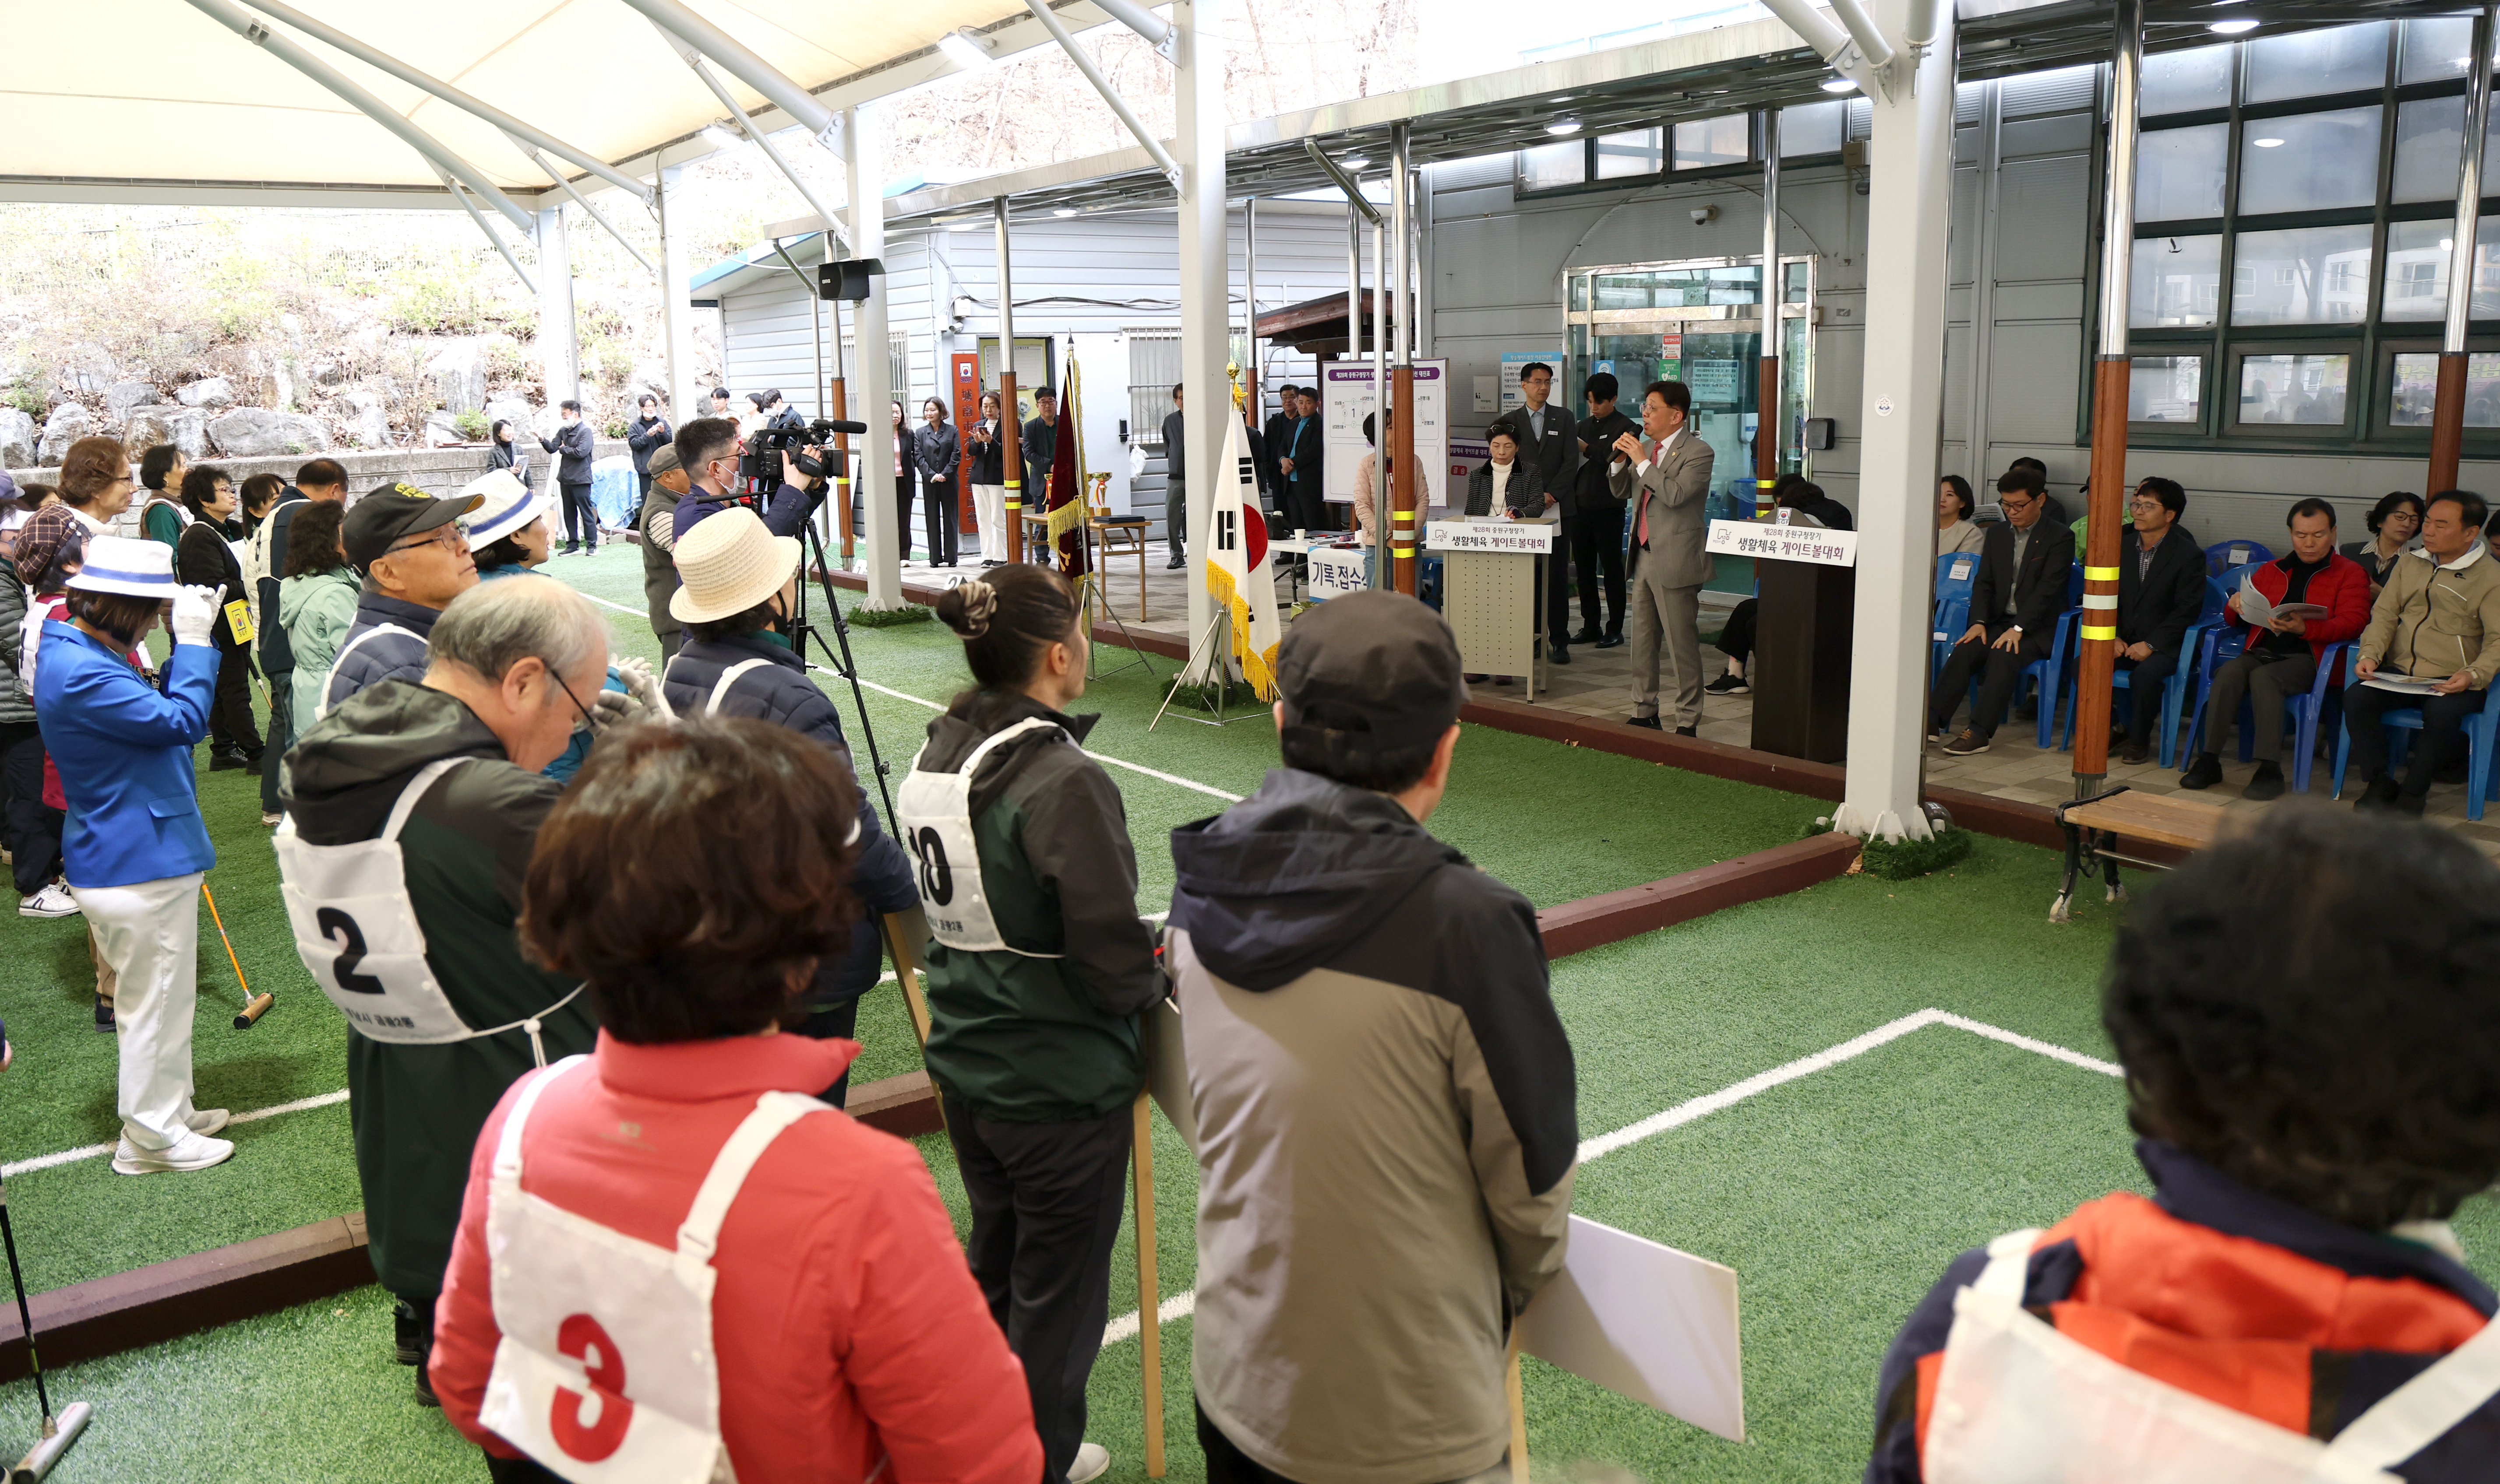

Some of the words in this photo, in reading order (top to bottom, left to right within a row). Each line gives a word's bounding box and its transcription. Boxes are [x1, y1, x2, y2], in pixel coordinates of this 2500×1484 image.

[1352, 408, 1355, 418] 1
[1452, 536, 1488, 547] 생활체육
[1491, 537, 1545, 549] 게이트볼대회
[1763, 528, 1783, 537] 제28회
[1785, 531, 1822, 540] 중원구청장기
[1738, 538, 1777, 554] 생활체육
[1781, 542, 1844, 560] 게이트볼대회
[948, 576, 958, 590] 2
[908, 826, 953, 906] 10
[316, 906, 385, 995] 2
[550, 1312, 634, 1463] 3
